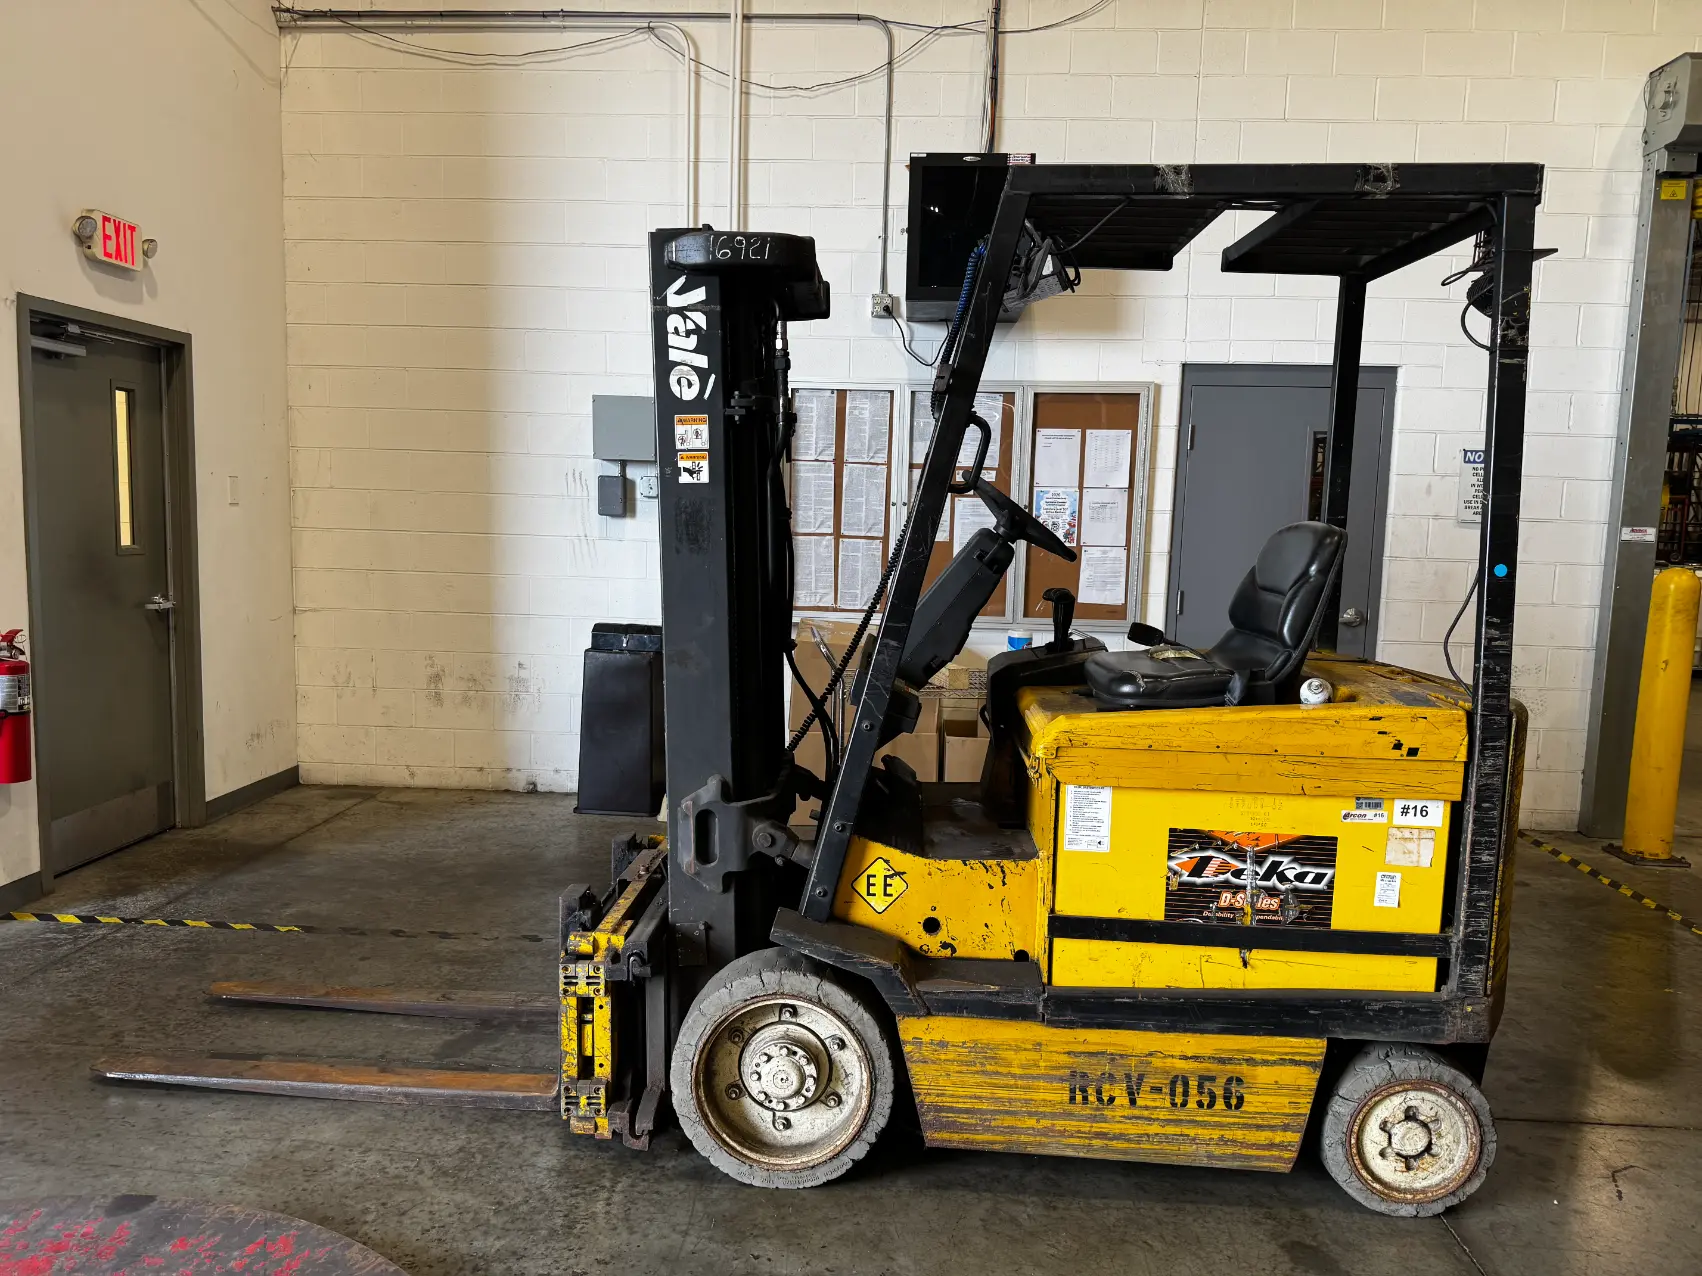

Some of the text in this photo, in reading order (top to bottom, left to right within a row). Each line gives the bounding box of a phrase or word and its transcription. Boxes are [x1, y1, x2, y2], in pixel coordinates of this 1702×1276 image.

[102, 215, 136, 266] EXIT
[709, 235, 770, 260] 16921
[662, 275, 713, 401] Yale
[1400, 803, 1429, 818] #16
[866, 874, 894, 898] EE
[1176, 854, 1330, 886] Deka
[1068, 1071, 1246, 1111] RCV-056
